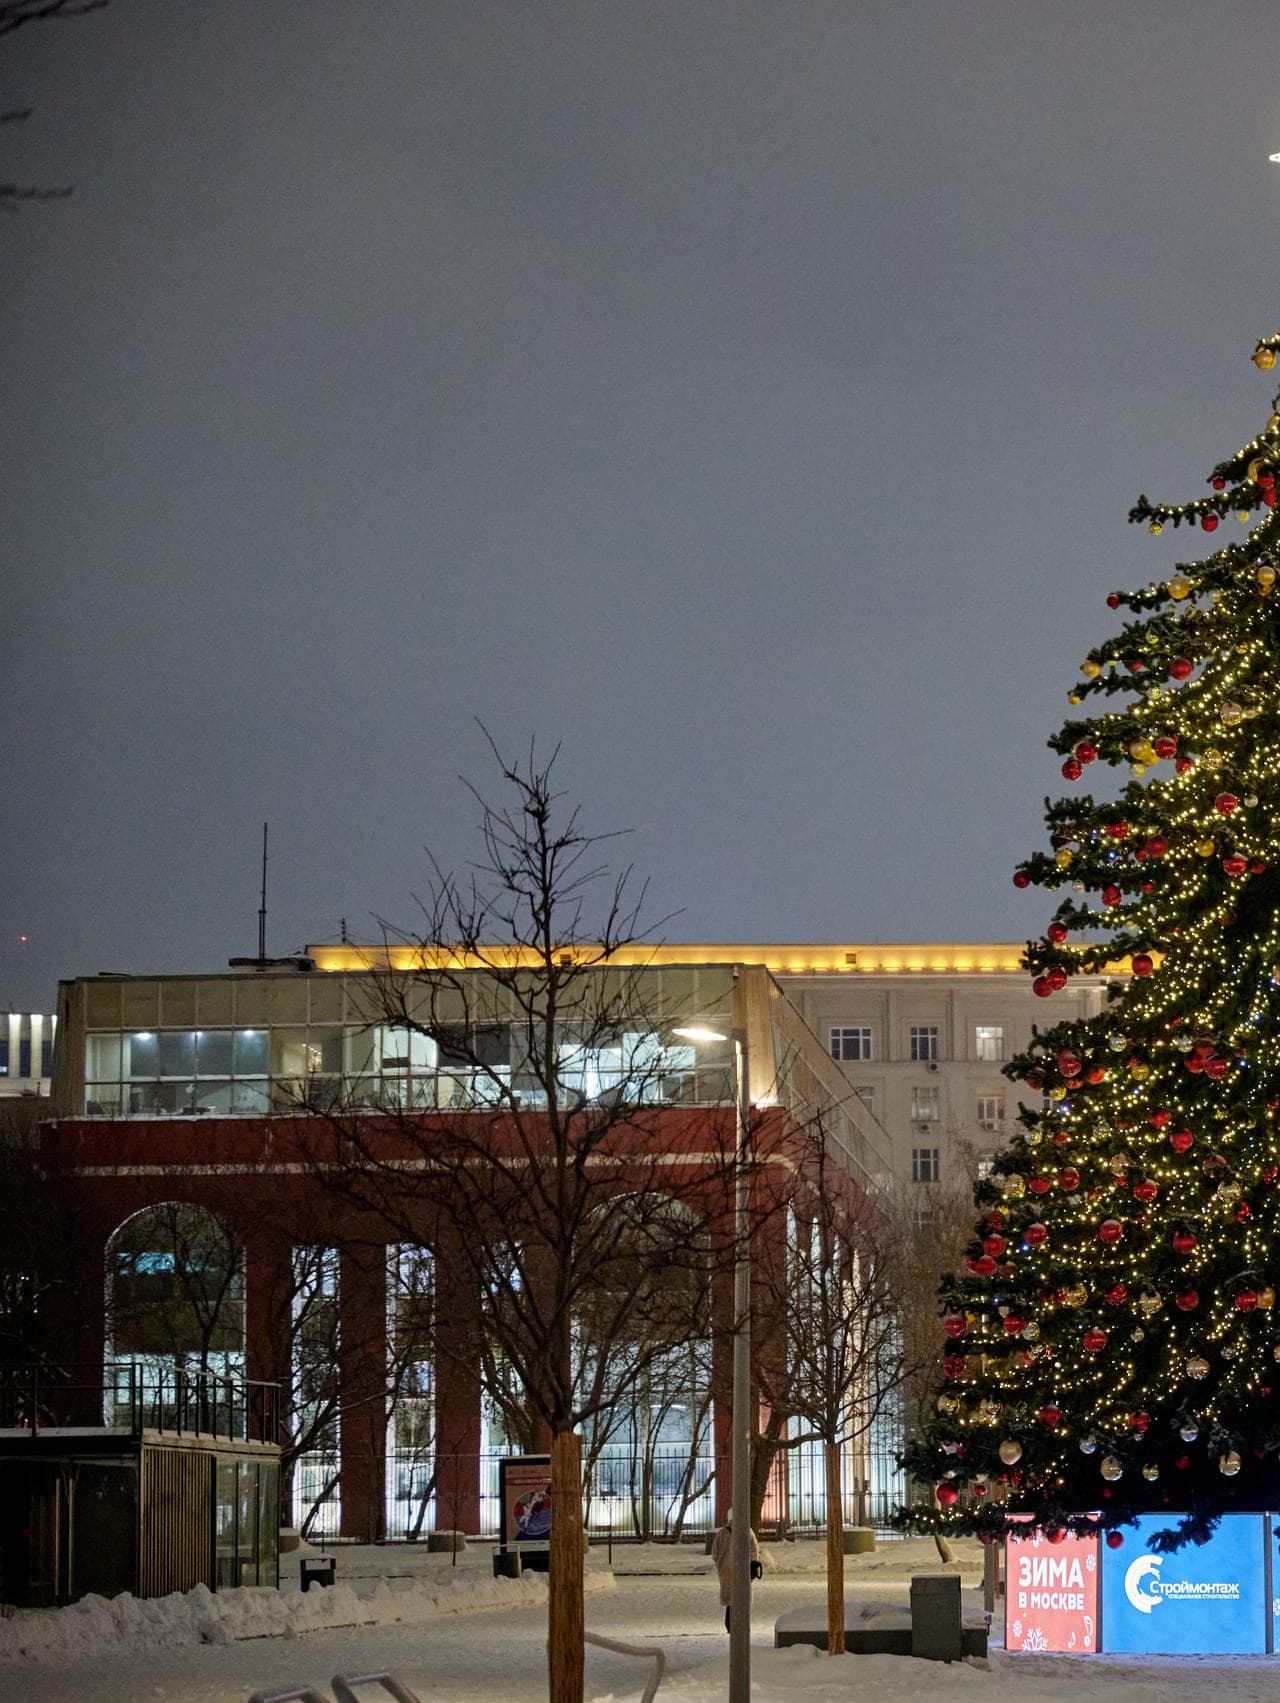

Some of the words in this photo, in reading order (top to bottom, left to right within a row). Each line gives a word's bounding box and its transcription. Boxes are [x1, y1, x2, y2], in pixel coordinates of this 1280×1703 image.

[1018, 1556, 1085, 1589] ЗИМА
[1149, 1580, 1240, 1596] Строймонтаж
[1018, 1591, 1028, 1609] В
[1030, 1591, 1085, 1611] МОСКВЕ
